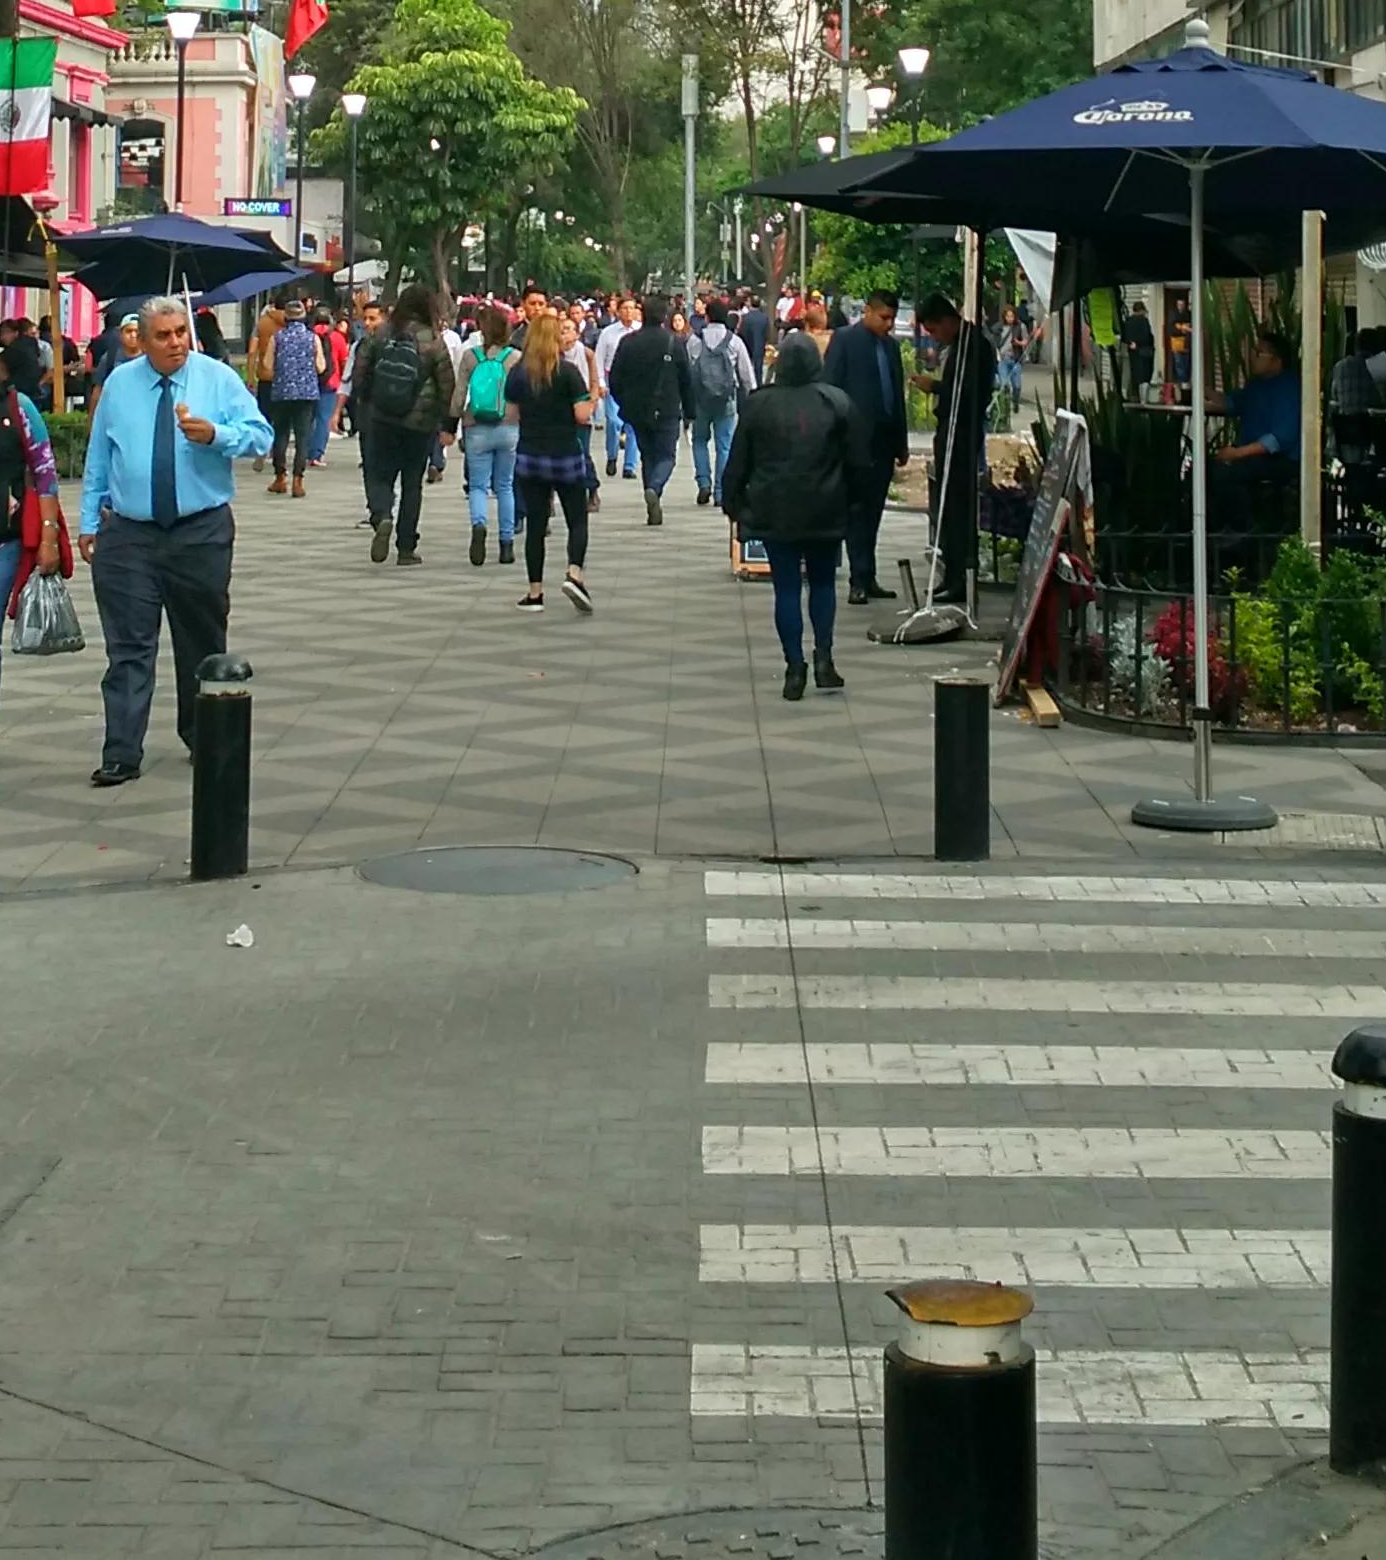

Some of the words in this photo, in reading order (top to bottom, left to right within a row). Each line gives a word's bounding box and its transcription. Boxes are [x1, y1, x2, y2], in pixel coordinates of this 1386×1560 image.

[1073, 108, 1194, 125] Corona
[232, 201, 246, 213] NO
[248, 201, 280, 213] COVER
